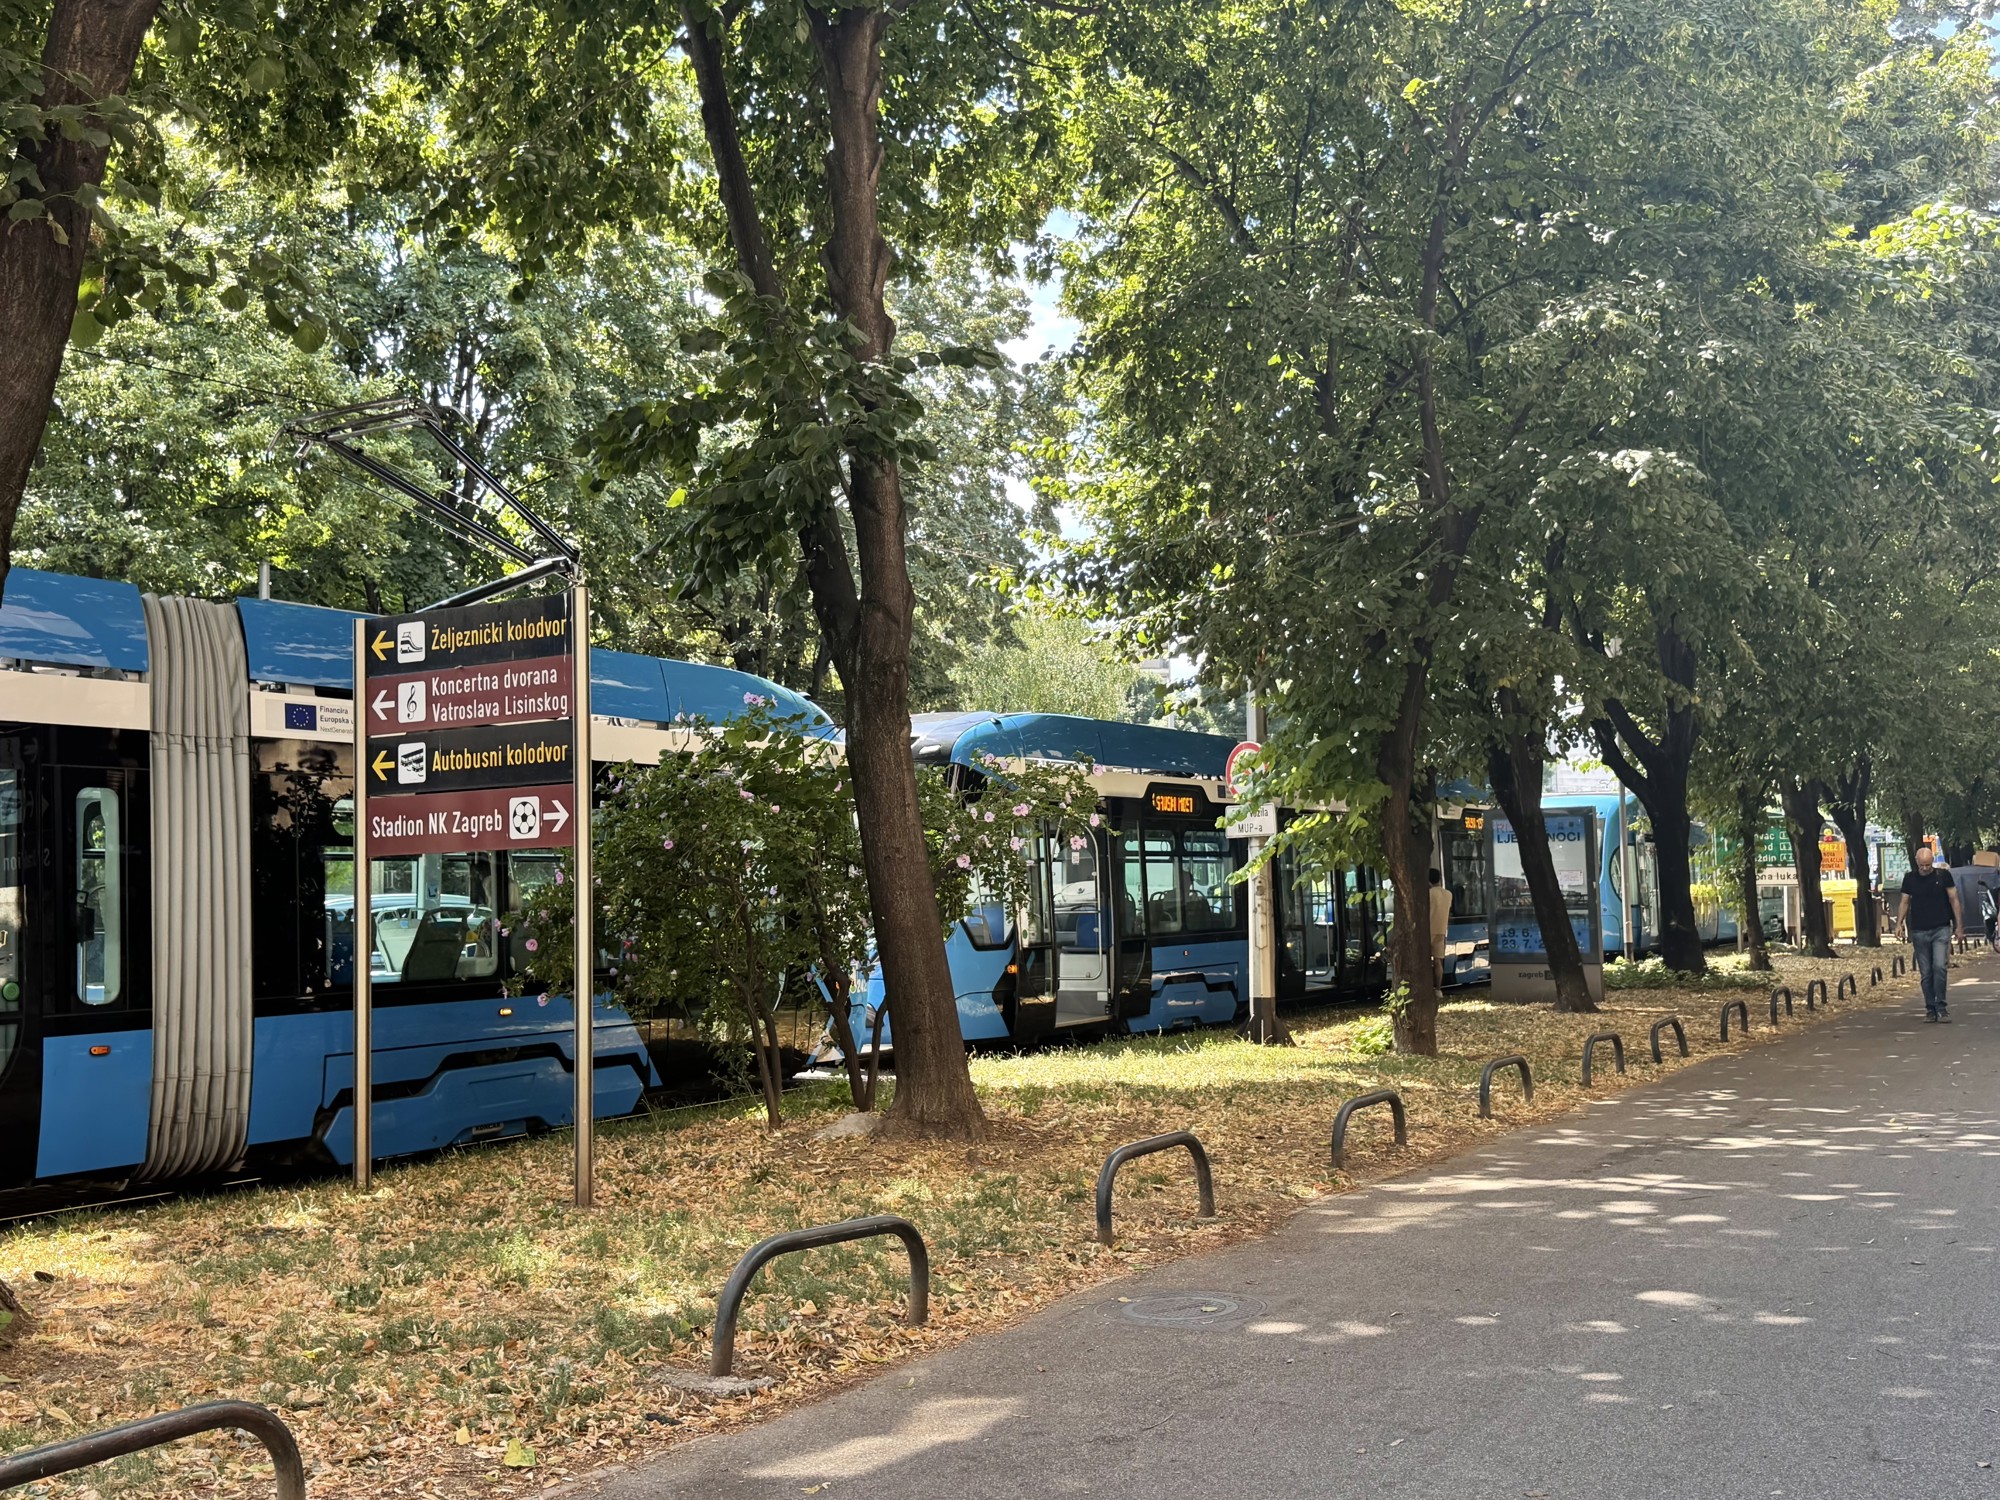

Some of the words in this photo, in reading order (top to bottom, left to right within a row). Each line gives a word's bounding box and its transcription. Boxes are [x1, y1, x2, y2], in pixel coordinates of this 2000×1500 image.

[431, 620, 503, 653] Željeznički
[507, 617, 567, 641] kolodvor
[432, 673, 499, 696] Koncertna
[503, 669, 558, 689] dvorana
[320, 705, 349, 714] Financira
[320, 715, 350, 724] Europska
[432, 700, 500, 722] Vatroslava
[505, 692, 568, 715] Lisinskog
[432, 746, 502, 772] Autobusni
[506, 741, 568, 763] kolodvor
[372, 815, 424, 838] Stadion
[428, 811, 448, 834] NK
[452, 809, 503, 838] Zagreb
[1238, 823, 1263, 833] MUP-a
[1518, 970, 1544, 980] zagreb
